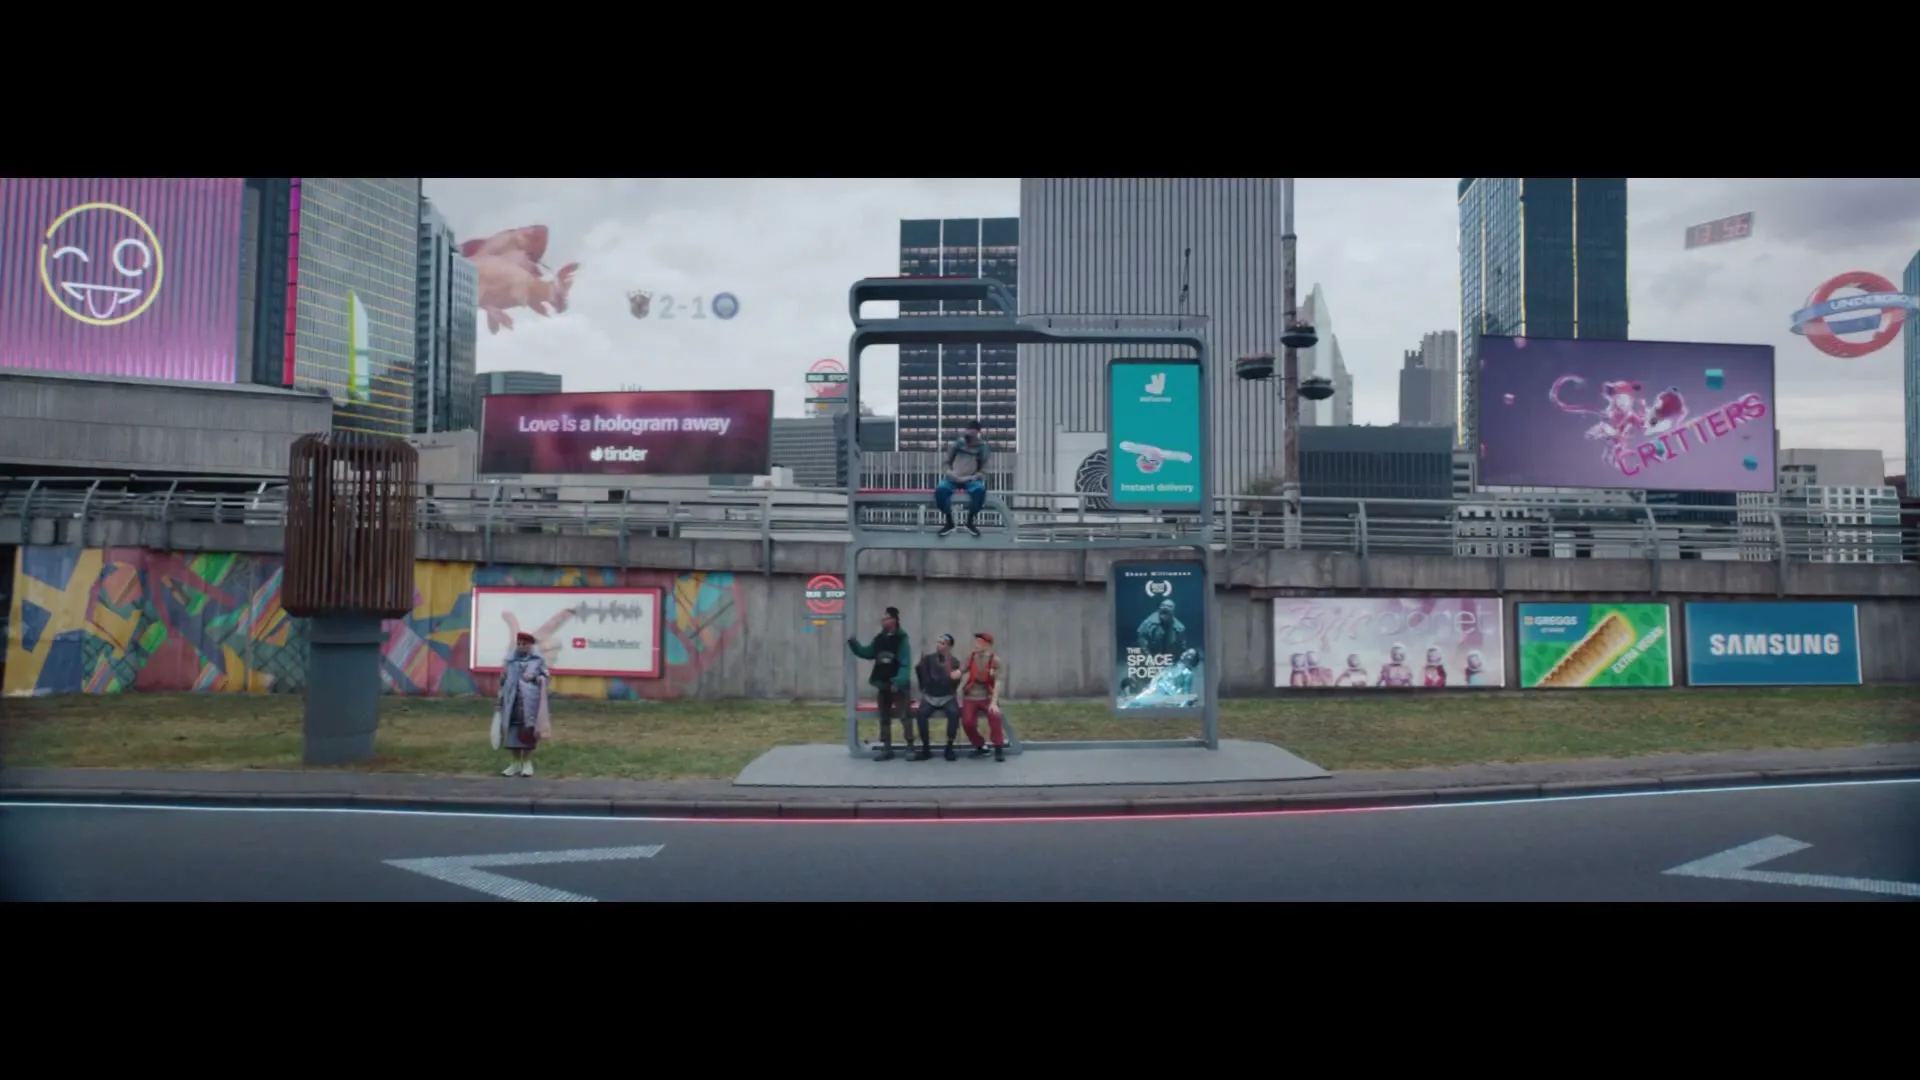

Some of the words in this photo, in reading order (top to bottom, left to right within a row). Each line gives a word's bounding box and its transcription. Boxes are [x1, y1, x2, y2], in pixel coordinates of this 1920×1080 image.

[519, 416, 560, 432] Love
[562, 415, 576, 432] is
[580, 418, 591, 432] a
[594, 415, 678, 435] hologram
[682, 418, 731, 435] away
[1616, 393, 1766, 476] CRITTERS
[605, 446, 648, 462] tinder
[1121, 483, 1155, 492] Instant
[1157, 482, 1193, 492] delivery
[1534, 615, 1578, 626] GREGGS
[1127, 647, 1141, 655] THE
[1709, 632, 1840, 656] SAMSUNG
[1127, 653, 1174, 667] SPACE
